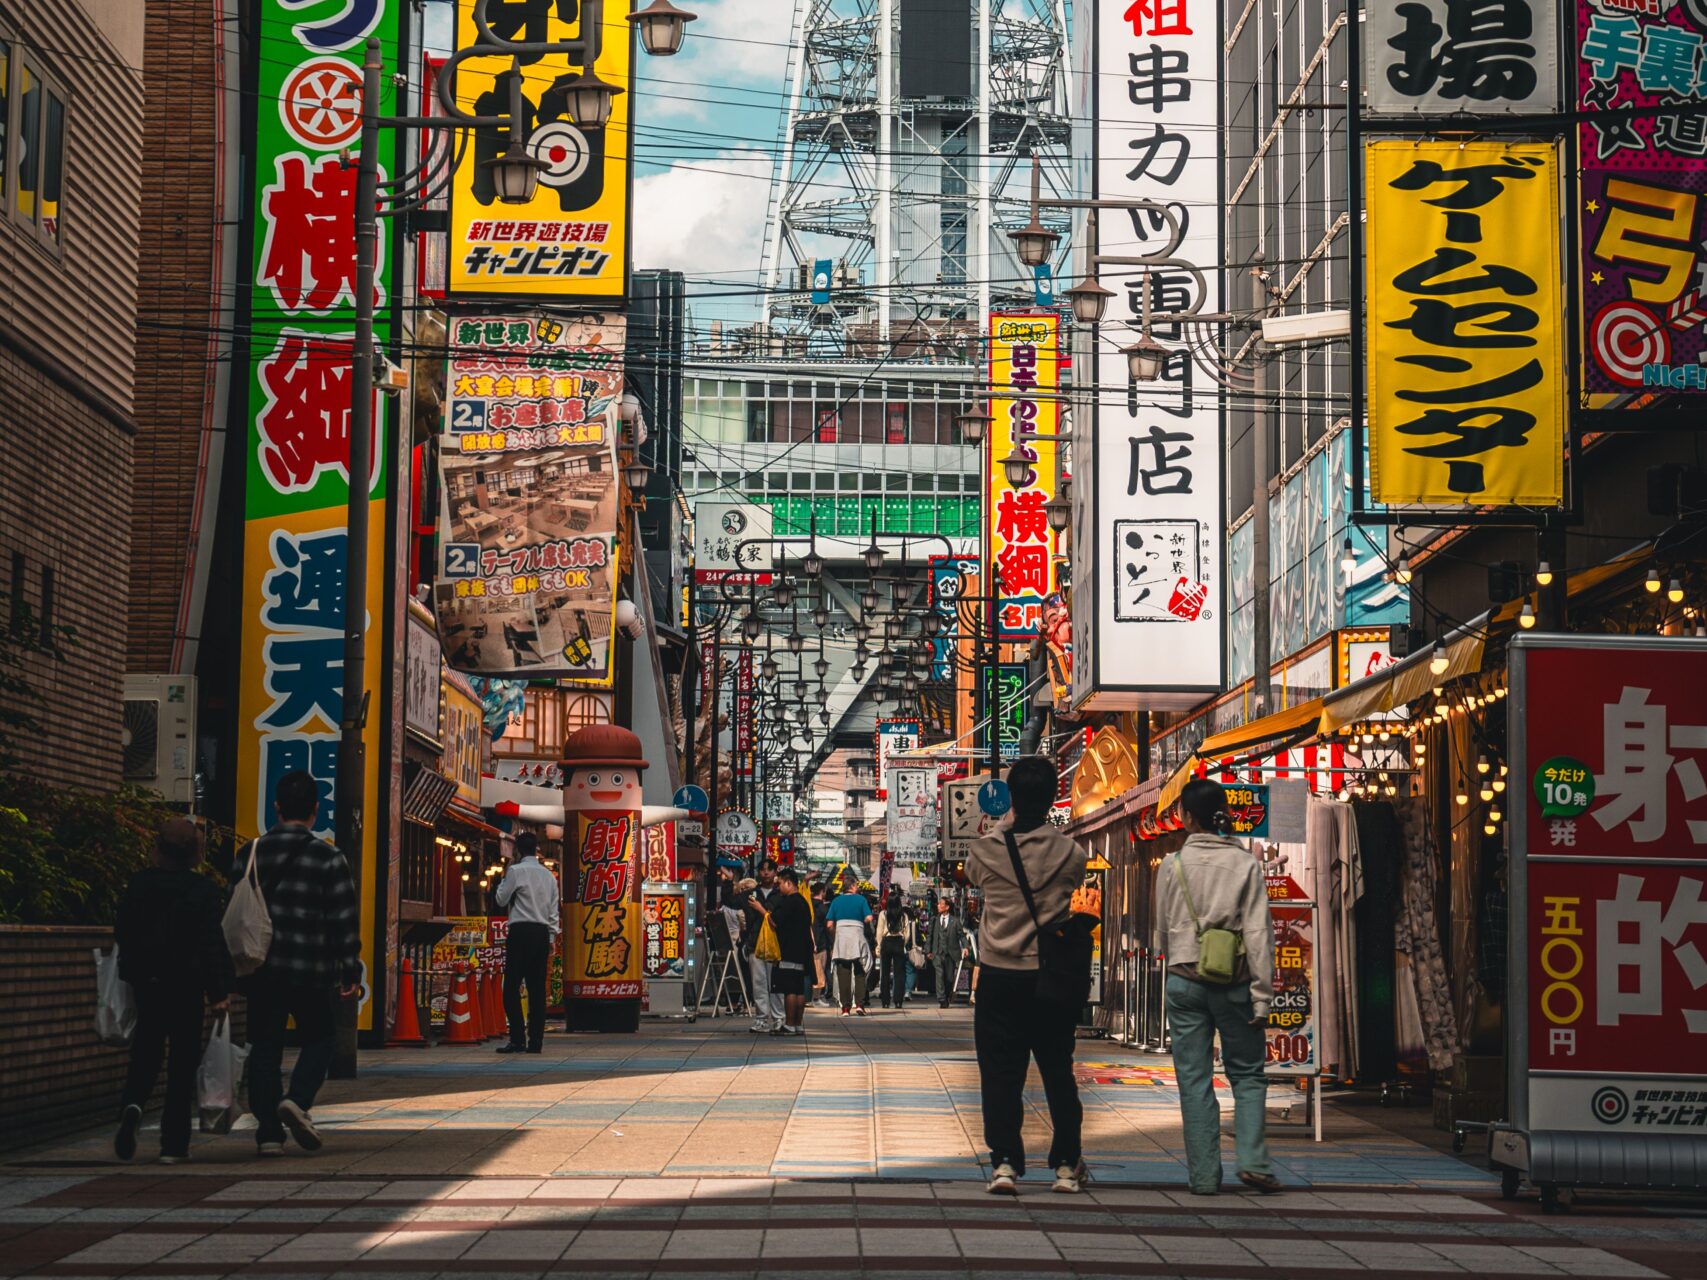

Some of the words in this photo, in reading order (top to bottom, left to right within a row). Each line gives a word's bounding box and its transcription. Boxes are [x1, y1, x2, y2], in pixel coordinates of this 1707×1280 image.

[1581, 14, 1707, 100] 手裏
[467, 222, 611, 244] 新世界遊技場
[1593, 177, 1698, 304] 弓
[466, 246, 612, 276] チャンピオン
[258, 152, 384, 493] 横綱
[457, 321, 532, 345] 新世界
[1383, 156, 1545, 494] ゲームセンター
[1642, 363, 1707, 391] NICE!
[482, 539, 605, 576] テーブル席も充実
[996, 490, 1050, 599] 横綱
[1544, 767, 1586, 782] 今だけ
[1225, 789, 1253, 805] 防犯
[1543, 783, 1587, 806] 10発
[579, 815, 631, 978] 射的体験
[661, 899, 681, 959] 24時間
[646, 925, 661, 972] 営業中
[597, 984, 638, 995] チャンピオン
[1631, 1105, 1707, 1127] チャンピオ
